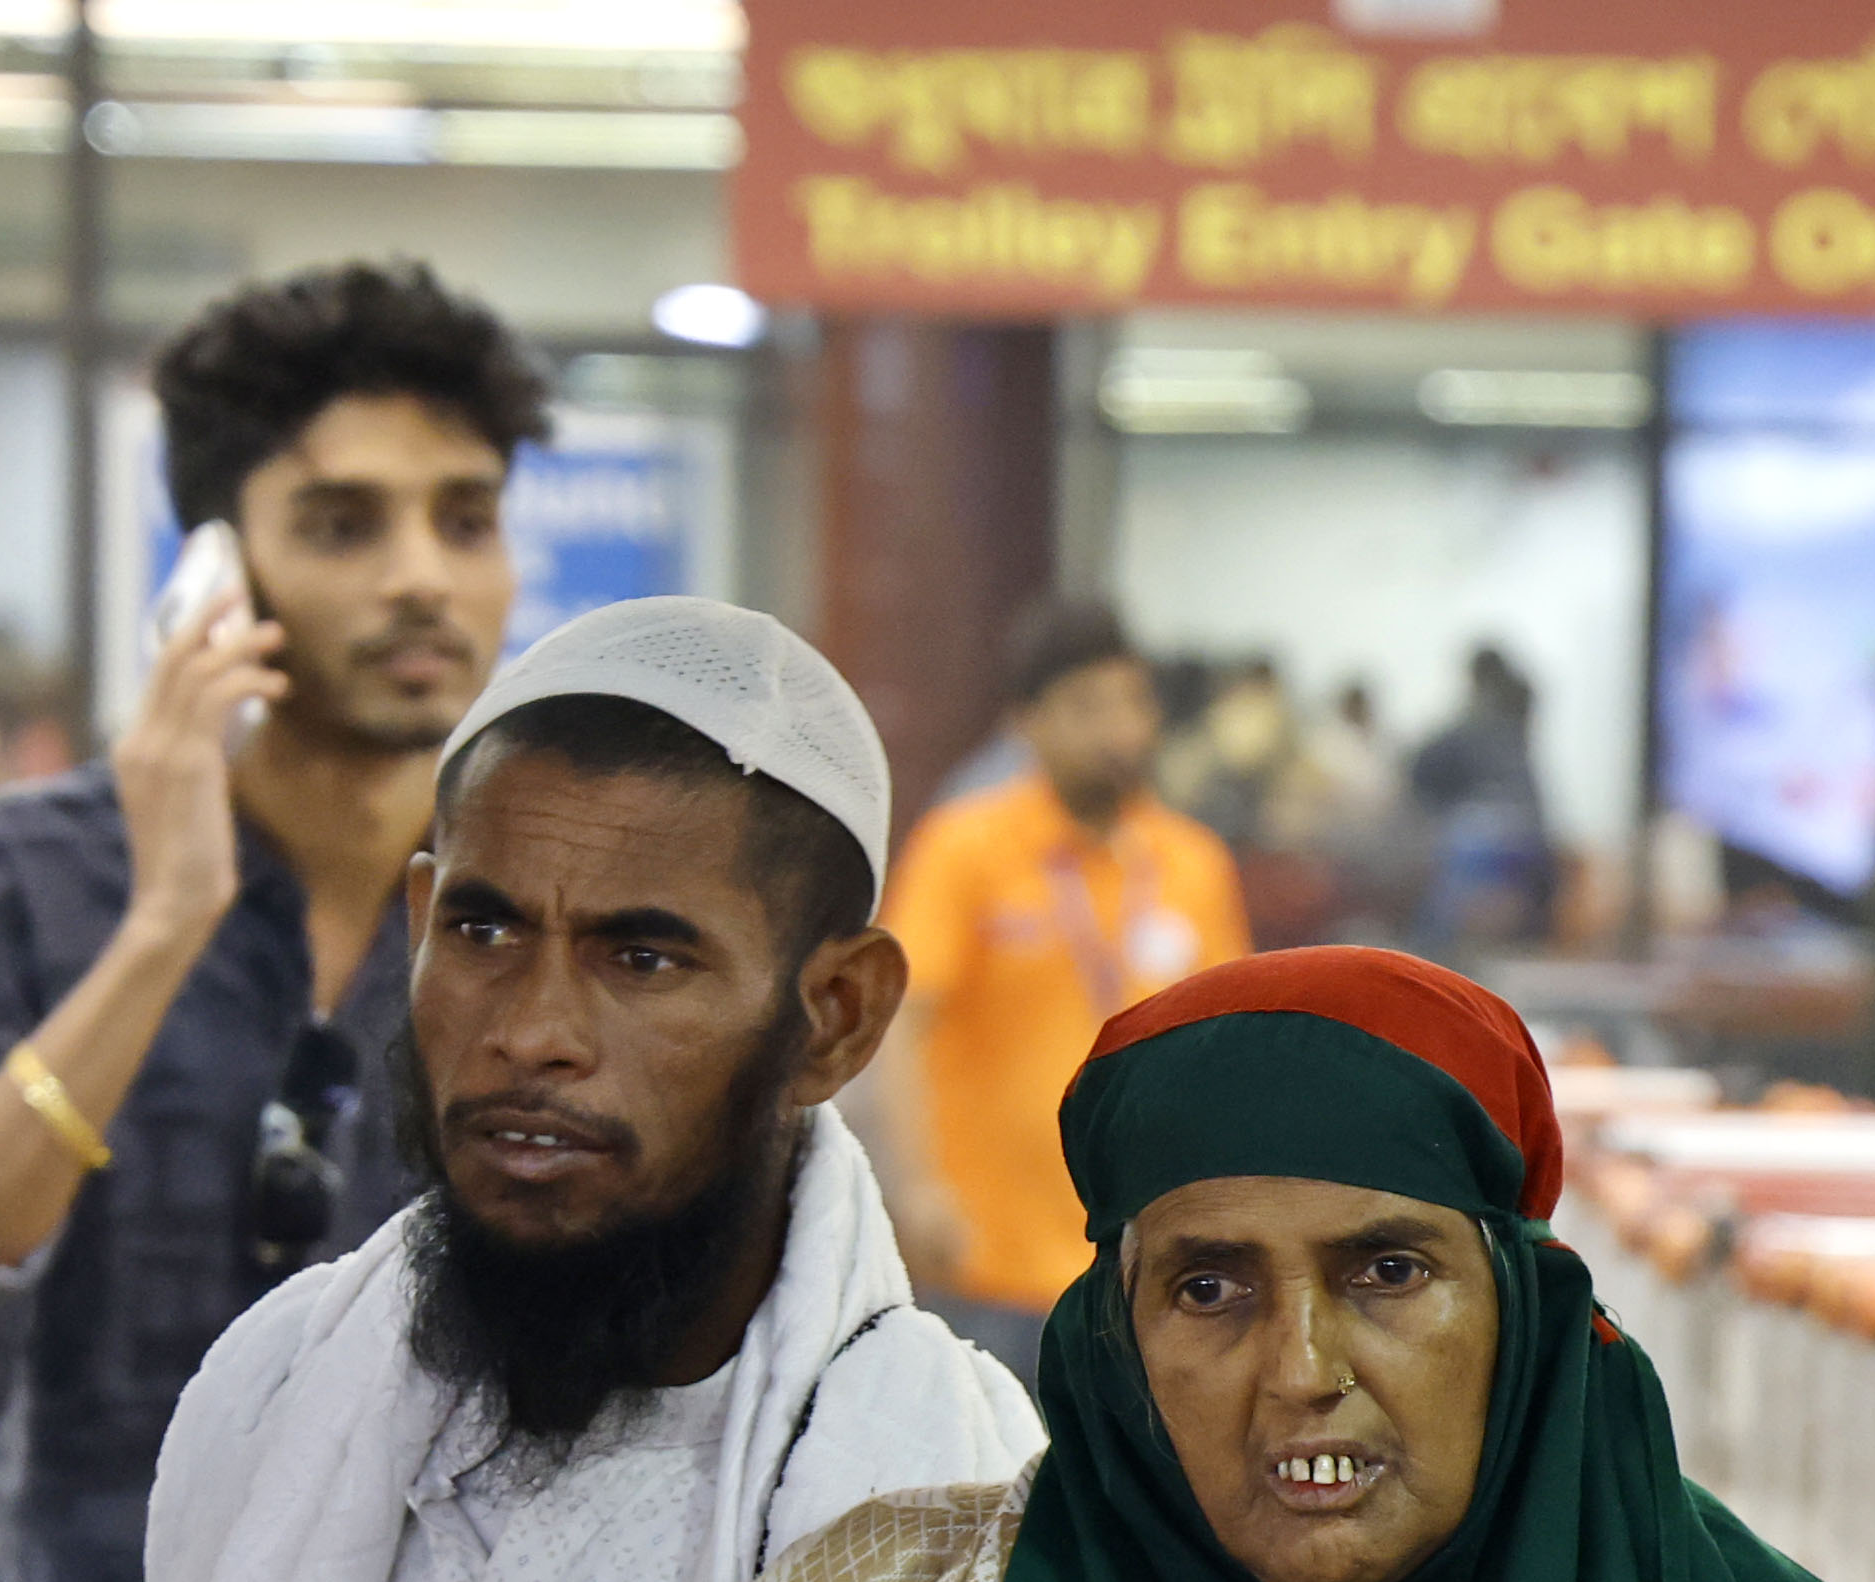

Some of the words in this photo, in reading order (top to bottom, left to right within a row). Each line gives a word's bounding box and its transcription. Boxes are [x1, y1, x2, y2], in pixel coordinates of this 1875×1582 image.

[797, 175, 1161, 297] Trolley
[1174, 180, 1477, 310] Entry
[1489, 186, 1757, 292] Gate
